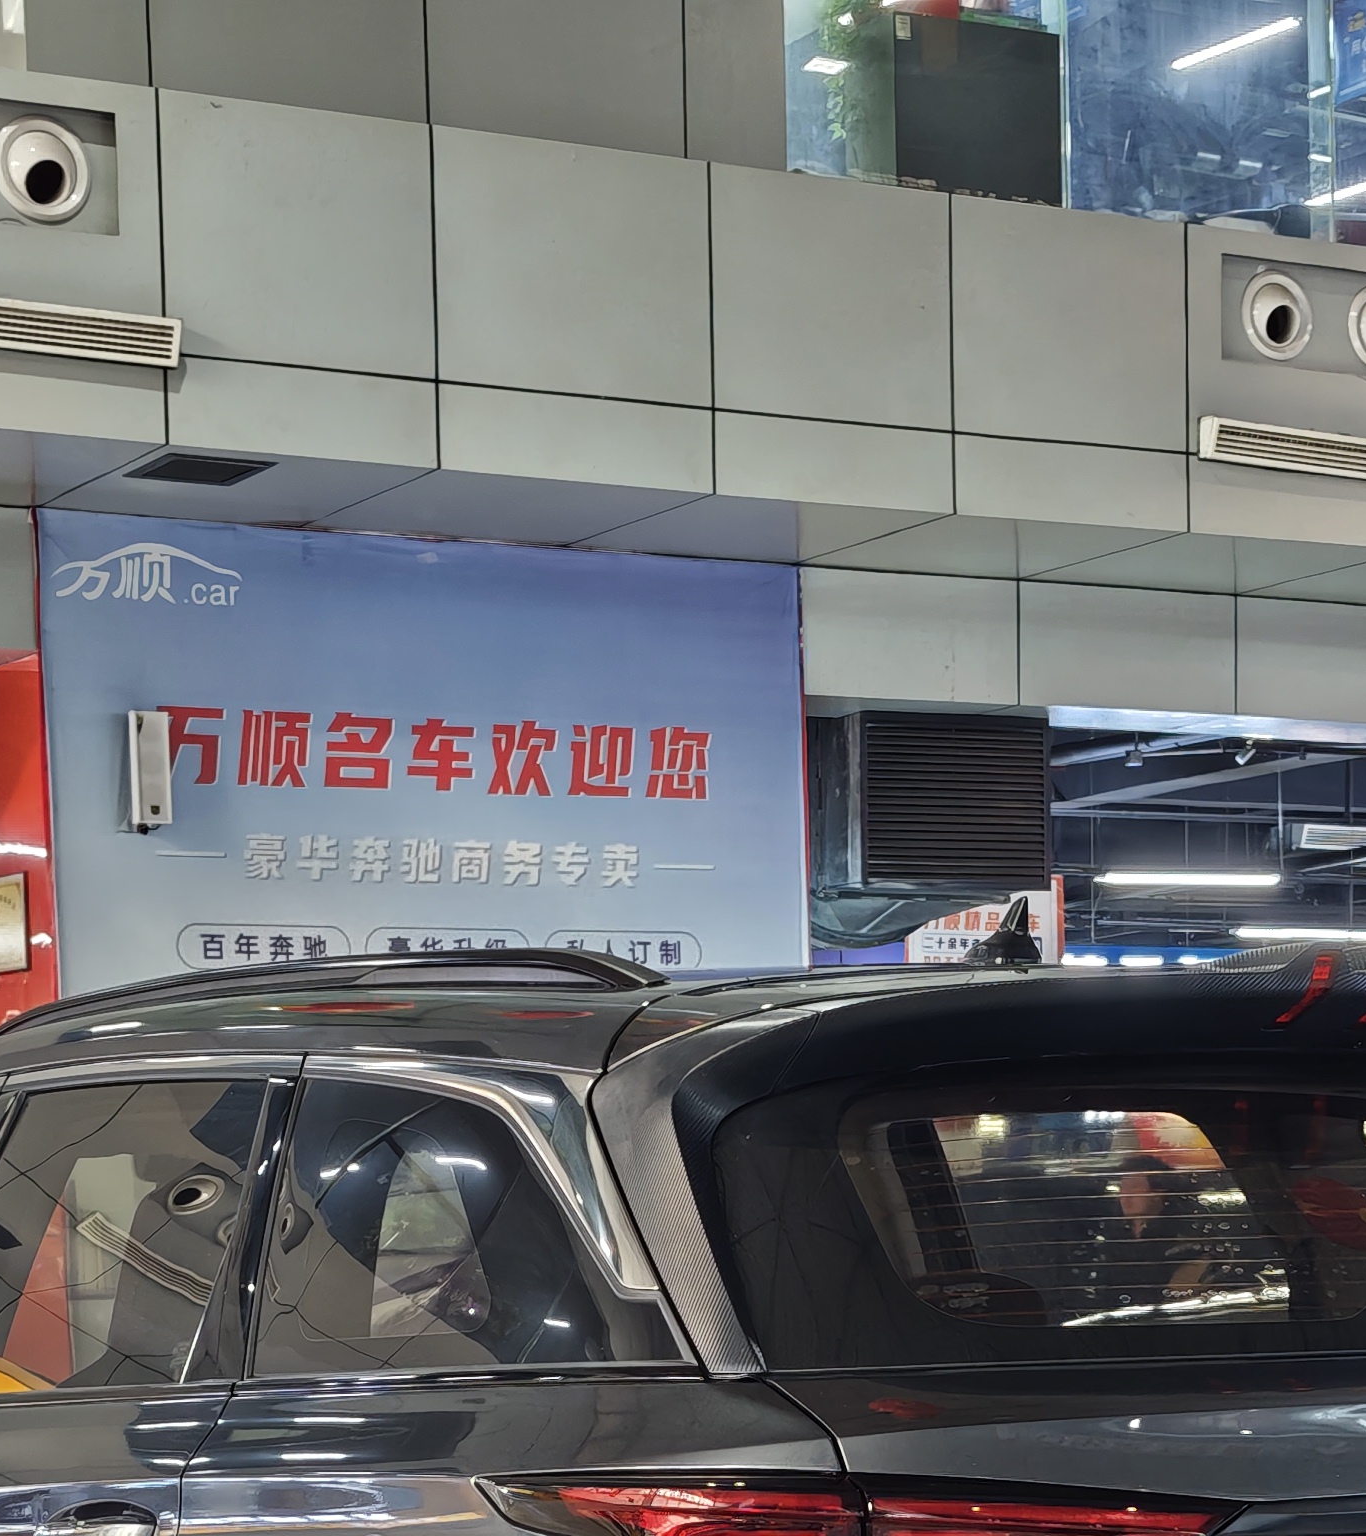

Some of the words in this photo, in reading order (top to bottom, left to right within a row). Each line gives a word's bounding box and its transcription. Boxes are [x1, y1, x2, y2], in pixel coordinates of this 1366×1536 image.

[50, 546, 176, 605] 万顺
[155, 704, 714, 801] 万顺名车欢迎您
[243, 833, 641, 888] 豪华奔驰商务专卖
[199, 932, 330, 961] 百年奔驰
